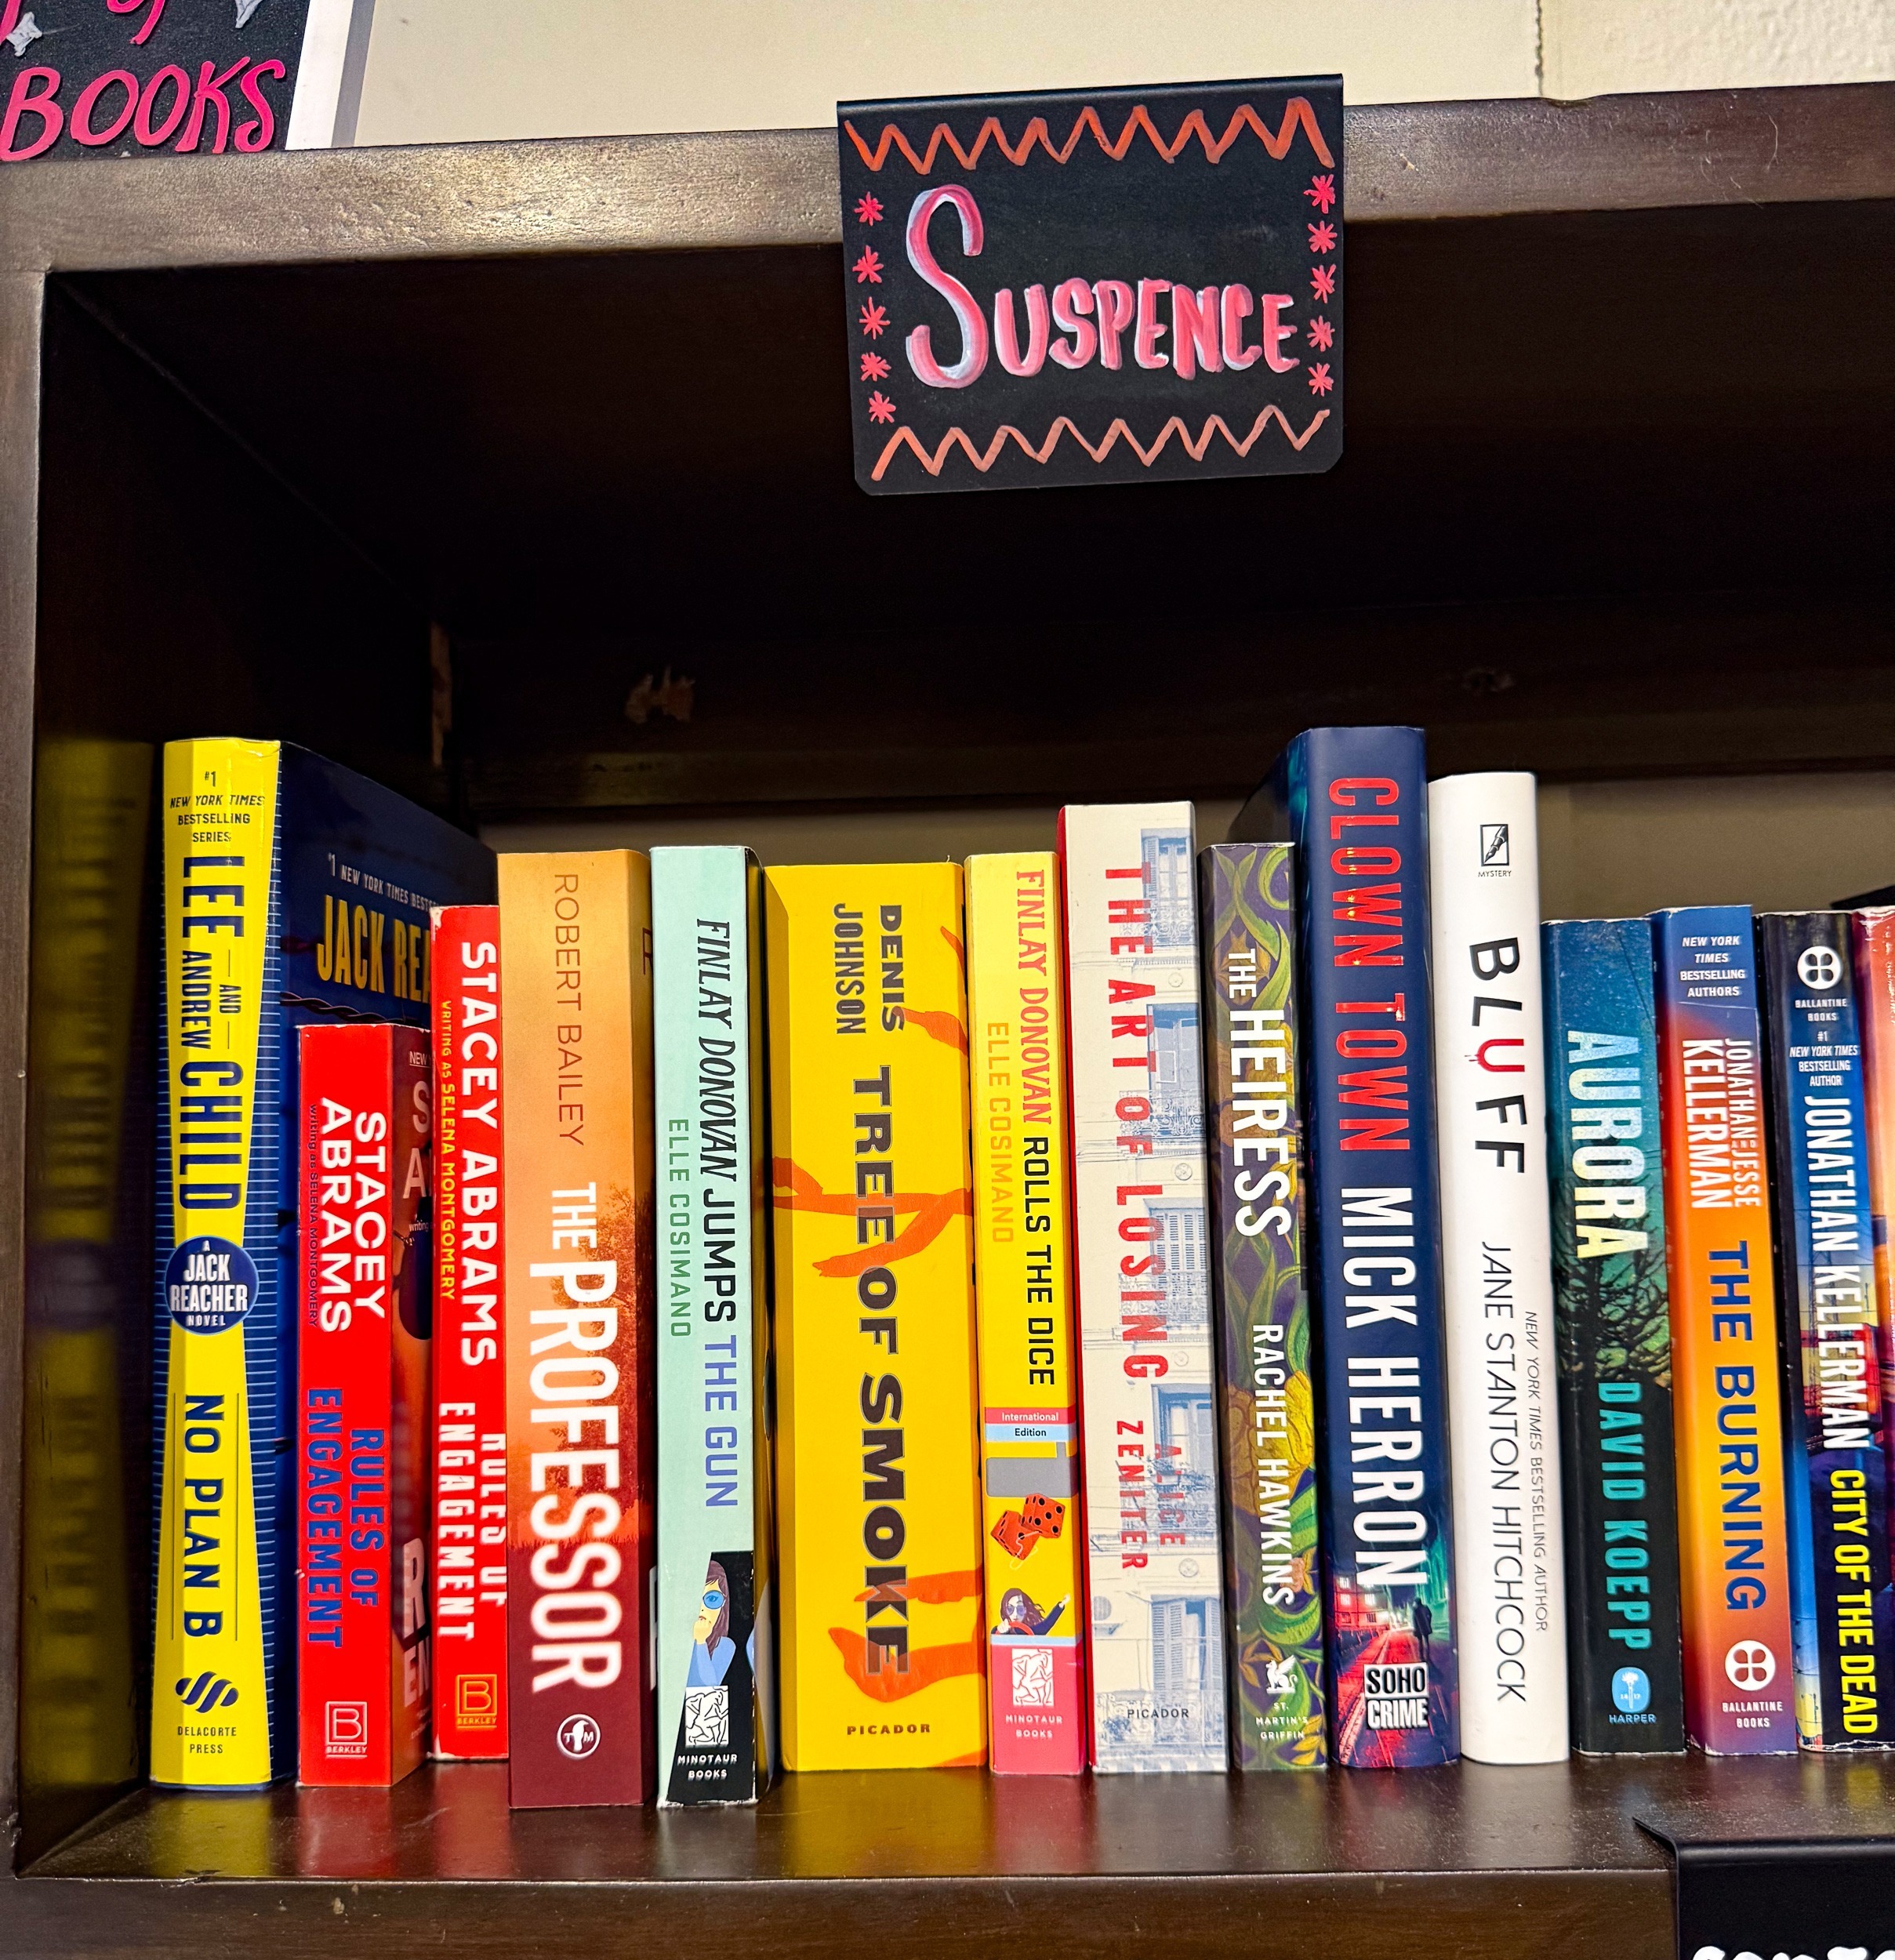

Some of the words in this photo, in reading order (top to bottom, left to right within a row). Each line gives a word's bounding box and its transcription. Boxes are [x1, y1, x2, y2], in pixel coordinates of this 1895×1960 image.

[0, 56, 285, 162] BOOKS
[906, 184, 1300, 389] SUSPENCE
[170, 797, 190, 808] NEW
[195, 796, 223, 806] YORK
[229, 795, 265, 806] TIMES
[205, 771, 216, 786] #1
[178, 813, 250, 826] BESTSELLING
[192, 831, 231, 843] SERIES
[183, 856, 245, 938] LEE
[329, 852, 336, 877] #1
[340, 865, 361, 886] NEW
[364, 873, 383, 895] YORK
[387, 883, 408, 903] TIMES
[1329, 778, 1403, 967] CLOWN
[554, 874, 581, 1011] ROBERT
[1016, 869, 1047, 976] FINLAY
[1105, 862, 1153, 955] THE
[1682, 937, 1708, 947] NEW
[1711, 935, 1741, 946] YORK
[316, 895, 385, 993] JACK
[697, 918, 732, 1029] FINLAY
[833, 902, 866, 1034] JOHNSON
[880, 905, 905, 1032] DENIS
[1228, 948, 1257, 999] THE
[1680, 970, 1746, 981] BESTSELLING
[1694, 953, 1730, 964] TIMES
[180, 950, 212, 1050] ANDREW
[220, 985, 241, 1014] AND
[1108, 979, 1156, 1072] ART
[1687, 986, 1741, 997] AUTHORS
[1795, 999, 1847, 1008] BALLANTINE
[1807, 1013, 1837, 1022] BOOKS
[409, 1051, 427, 1066] NEW
[441, 1000, 452, 1056] WRITING
[462, 942, 498, 1129] STACEY
[988, 1022, 1011, 1087] ELLE
[1019, 988, 1051, 1125] DONOVAN
[1469, 937, 1528, 1174] BLUFF
[1789, 1047, 1810, 1058] NEW
[1811, 1046, 1832, 1056] YORK
[1835, 1045, 1858, 1055] TIMES
[1817, 1031, 1828, 1041] #1
[441, 1062, 452, 1078] AS
[557, 1025, 584, 1146] BAILEY
[1335, 993, 1410, 1151] TOWN
[1725, 1038, 1759, 1139] JONATHAN
[1799, 1060, 1851, 1072] BESTSELLING
[1810, 1076, 1842, 1087] AUTHOR
[180, 1061, 244, 1210] CHILD
[308, 1105, 317, 1149] writing
[441, 1083, 455, 1152] SELENA
[699, 1036, 737, 1181] DONOVAN
[1115, 1098, 1153, 1156] OF
[1230, 1009, 1291, 1237] HEIRESS
[1682, 1039, 1733, 1208] KELLERMAN
[309, 1154, 316, 1169] as
[669, 1119, 689, 1181] ELLE
[853, 1065, 895, 1244] TREE
[989, 1098, 1014, 1243] COSIMANO
[1567, 1030, 1648, 1258] AURORA
[1731, 1140, 1756, 1149] AND
[1731, 1149, 1762, 1207] JESSE
[1804, 1096, 1858, 1252] JONATHAN
[310, 1172, 318, 1224] SELENA
[320, 1097, 351, 1332] ABRAMS
[354, 1112, 387, 1319] STACEY
[552, 1181, 597, 1250] THE
[1023, 1137, 1051, 1232] ROLLS
[202, 1240, 211, 1252] A
[441, 1163, 455, 1299] MONTGOMERY
[461, 1149, 497, 1366] ABRAMS
[670, 1194, 691, 1337] COSIMANO
[703, 1189, 736, 1323] JUMPS
[1341, 1187, 1418, 1330] MICK
[170, 1285, 248, 1312] REACHER
[183, 1254, 230, 1282] JACK
[308, 1228, 318, 1327] MONTGOMERY
[1026, 1244, 1052, 1304] THE
[1116, 1185, 1168, 1378] LOSING
[1482, 1241, 1514, 1319] JANE
[1708, 1240, 1752, 1342] THE
[187, 1315, 226, 1327] NOVEL
[857, 1265, 898, 1355] OF
[1525, 1311, 1538, 1350] NEW
[704, 1334, 737, 1411] THE
[1028, 1317, 1055, 1385] DICE
[1253, 1324, 1287, 1446] RACHEL
[1527, 1356, 1540, 1399] YORK
[1813, 1265, 1870, 1449] KELLERMAN
[184, 1394, 224, 1453] NO
[1001, 1412, 1059, 1422] International
[1015, 1428, 1047, 1437] Edition
[1485, 1333, 1519, 1490] STANTON
[1529, 1404, 1542, 1450] TIMES
[1598, 1382, 1646, 1501] DAVID
[350, 1428, 384, 1550] RULES
[529, 1260, 623, 1693] PROFESSOR
[705, 1426, 738, 1507] GUN
[1116, 1421, 1148, 1569] ZENITER
[1155, 1443, 1185, 1544] ALICE
[1347, 1356, 1428, 1585] HERRON
[1715, 1366, 1766, 1610] BURNING
[183, 1479, 223, 1588] PLAN
[308, 1388, 343, 1649] ENGAGEMENT
[438, 1403, 475, 1641] ENGAGEMENT
[859, 1372, 909, 1675] SMOKE
[1257, 1458, 1294, 1606] HAWKINS
[1530, 1457, 1546, 1558] BESTSELLING
[1830, 1469, 1869, 1537] CITY
[350, 1568, 379, 1607] OF
[1534, 1563, 1547, 1632] AUTHOR
[1603, 1520, 1652, 1650] KOEPP
[1835, 1544, 1870, 1583] OF
[184, 1611, 223, 1637] B
[1492, 1506, 1526, 1702] HITCHCOCK
[1837, 1589, 1874, 1646] THE
[1127, 1708, 1189, 1719] PICADOR
[1273, 1702, 1289, 1711] ST.
[1366, 1665, 1426, 1694] SOHO
[1367, 1699, 1428, 1728] CRIME
[1723, 1701, 1783, 1712] BALLANTINE
[1840, 1654, 1878, 1734] DEAD
[177, 1726, 237, 1737] DELACORTE
[189, 1743, 223, 1754] PRESS
[325, 1745, 367, 1755] BERKLEY
[847, 1723, 931, 1736] PICADOR
[1005, 1715, 1062, 1724] MINOTAUR
[1016, 1730, 1052, 1738] BOOKS
[1255, 1716, 1309, 1726] MARTIN'S
[1260, 1730, 1305, 1740] GRIFFIN
[1609, 1714, 1657, 1724] HARPER
[1737, 1718, 1770, 1728] BOOKS
[677, 1753, 738, 1764] MINOTAUR
[688, 1769, 728, 1779] BOOKS
